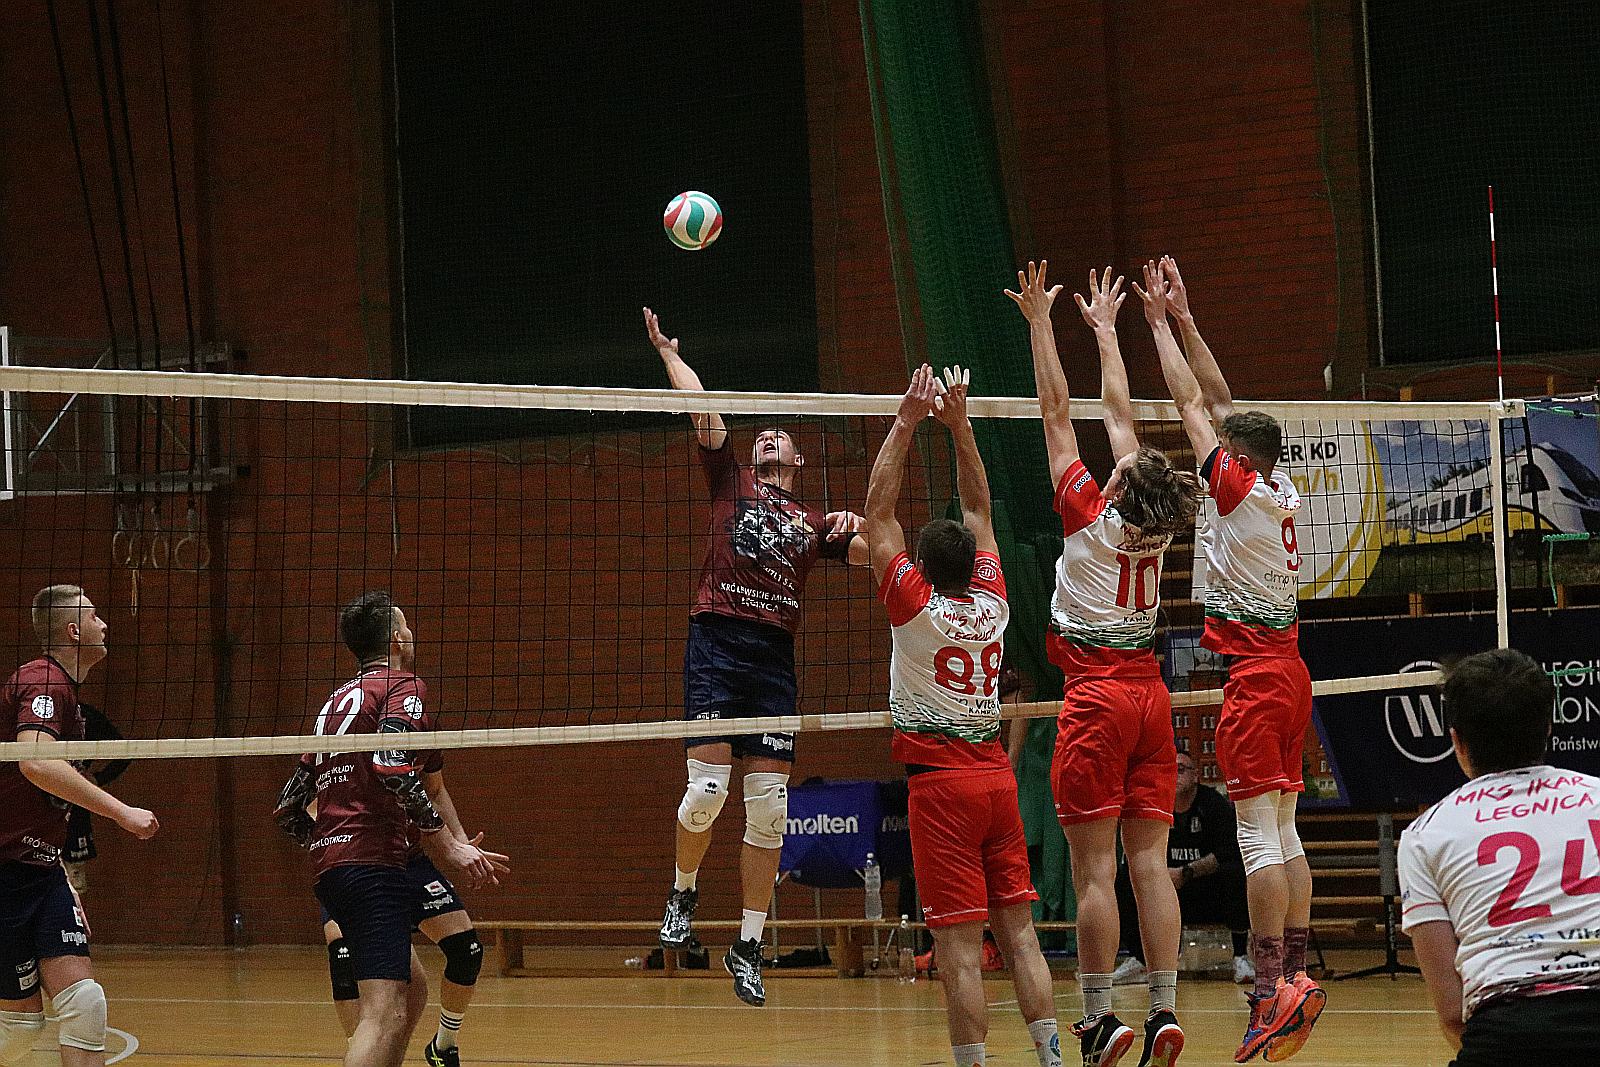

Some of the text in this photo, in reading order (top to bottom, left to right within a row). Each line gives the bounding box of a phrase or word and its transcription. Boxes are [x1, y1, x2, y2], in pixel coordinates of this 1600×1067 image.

[1310, 441, 1337, 460] KD
[1281, 516, 1302, 571] 9
[1115, 552, 1158, 610] 10
[934, 642, 1001, 697] 88
[1455, 775, 1595, 806] MKS IKAR
[1475, 792, 1594, 823] LEGNICA
[784, 813, 859, 834] molten
[1477, 819, 1600, 928] 24
